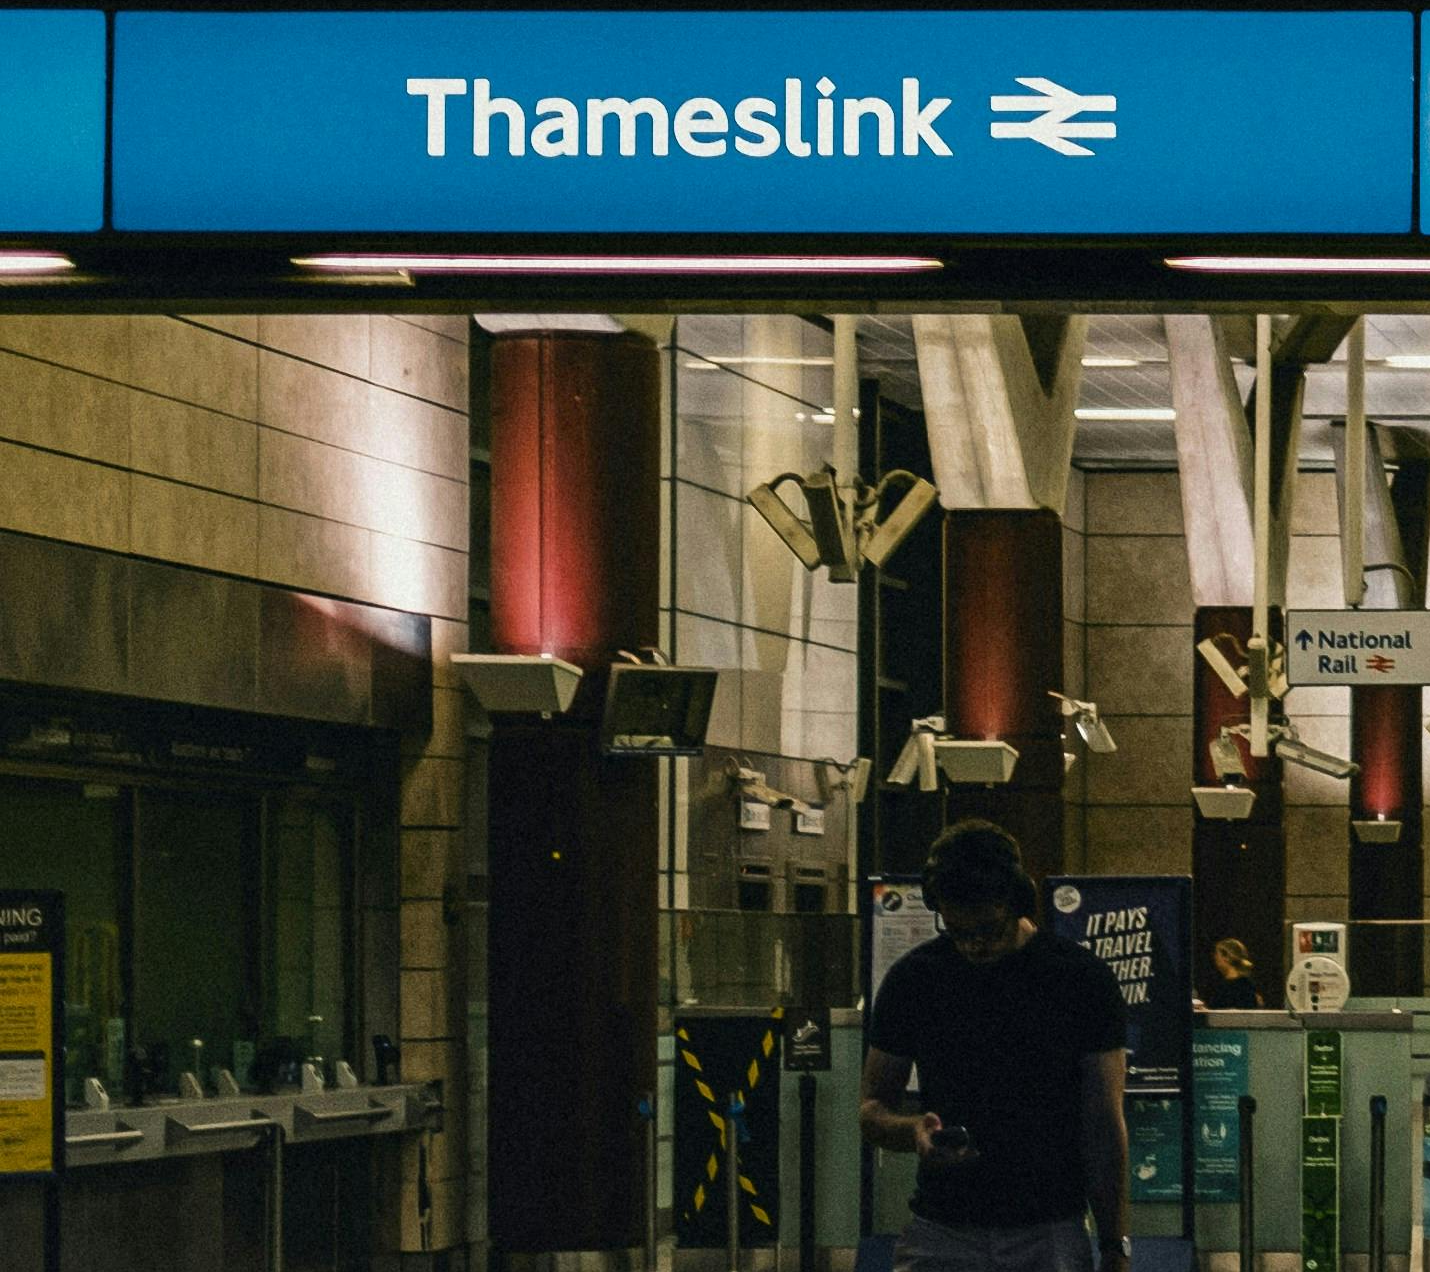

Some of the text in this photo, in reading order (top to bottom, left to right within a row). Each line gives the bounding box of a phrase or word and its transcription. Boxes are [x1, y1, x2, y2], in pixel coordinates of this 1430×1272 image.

[407, 77, 952, 157] Thameslink
[1319, 630, 1412, 650] National
[1319, 654, 1359, 674] Rail
[1086, 906, 1147, 937] IT PAYS
[1095, 931, 1152, 959] TRAVEL
